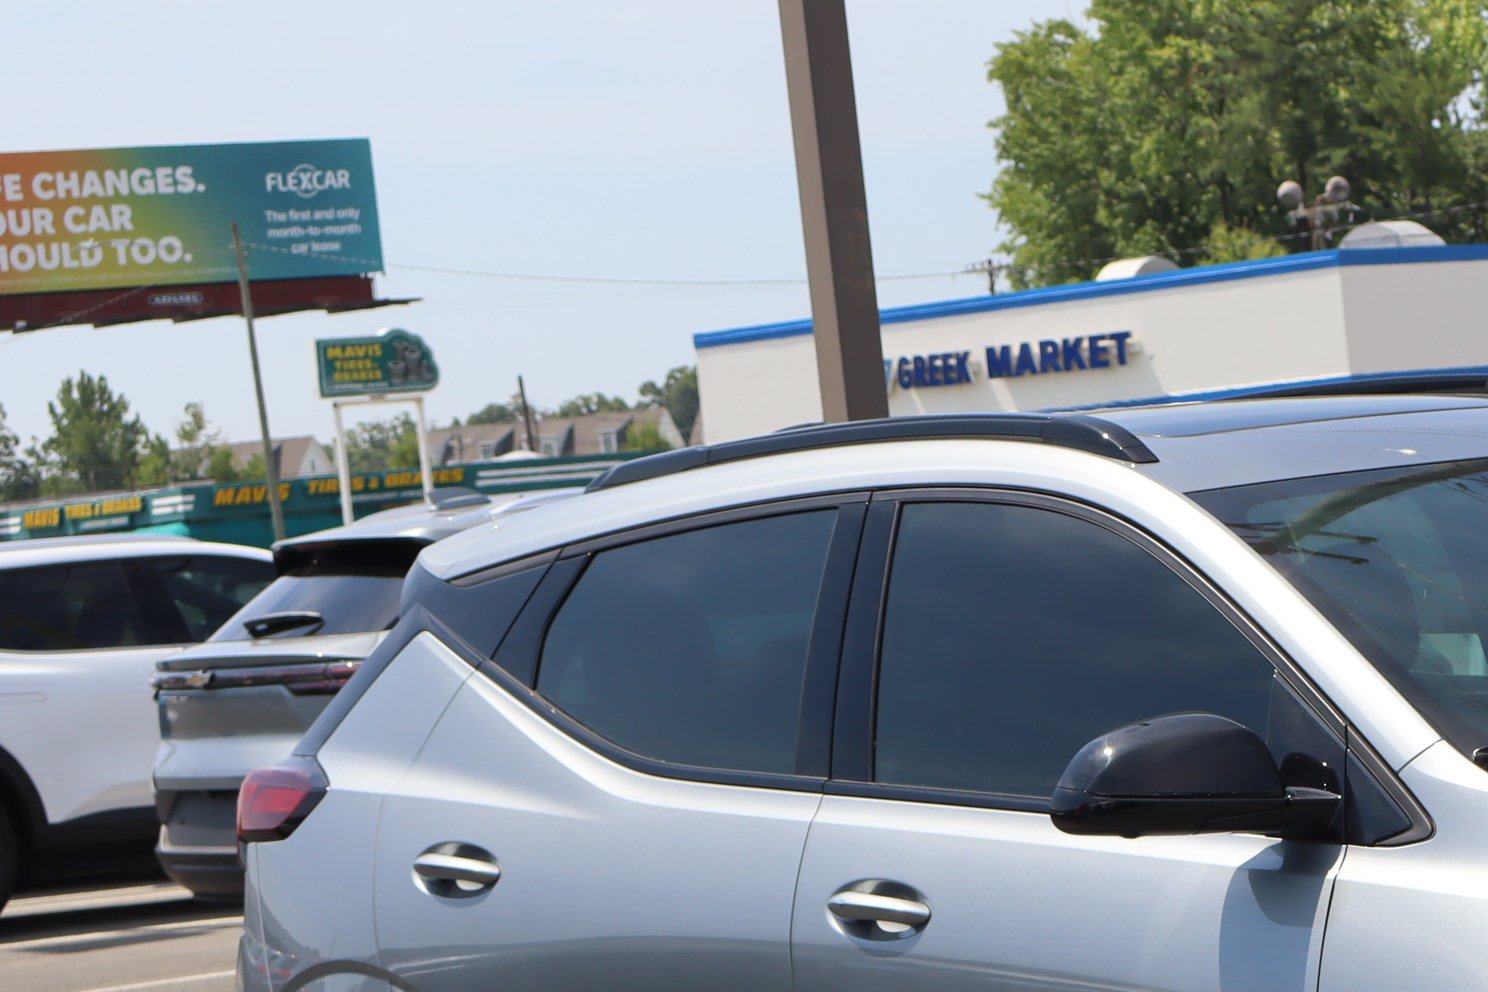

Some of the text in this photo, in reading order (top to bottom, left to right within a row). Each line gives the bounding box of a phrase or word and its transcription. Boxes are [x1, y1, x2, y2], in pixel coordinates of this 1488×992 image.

[0, 165, 206, 202] E CHANGES.
[265, 169, 351, 193] FLEXCAR
[0, 203, 135, 237] UR CAR
[265, 209, 288, 222] The
[313, 208, 335, 220] and
[336, 206, 360, 221] only
[110, 235, 193, 267] TOO.
[326, 343, 382, 359] MAVIS
[898, 330, 1132, 389] GREEK MARKET
[333, 369, 382, 383] BRAKES
[214, 482, 291, 506] MAVS
[309, 476, 365, 495] TIRS
[25, 508, 60, 528] MAVIS
[65, 503, 92, 520] TIRES
[103, 497, 142, 515] BRAKES
